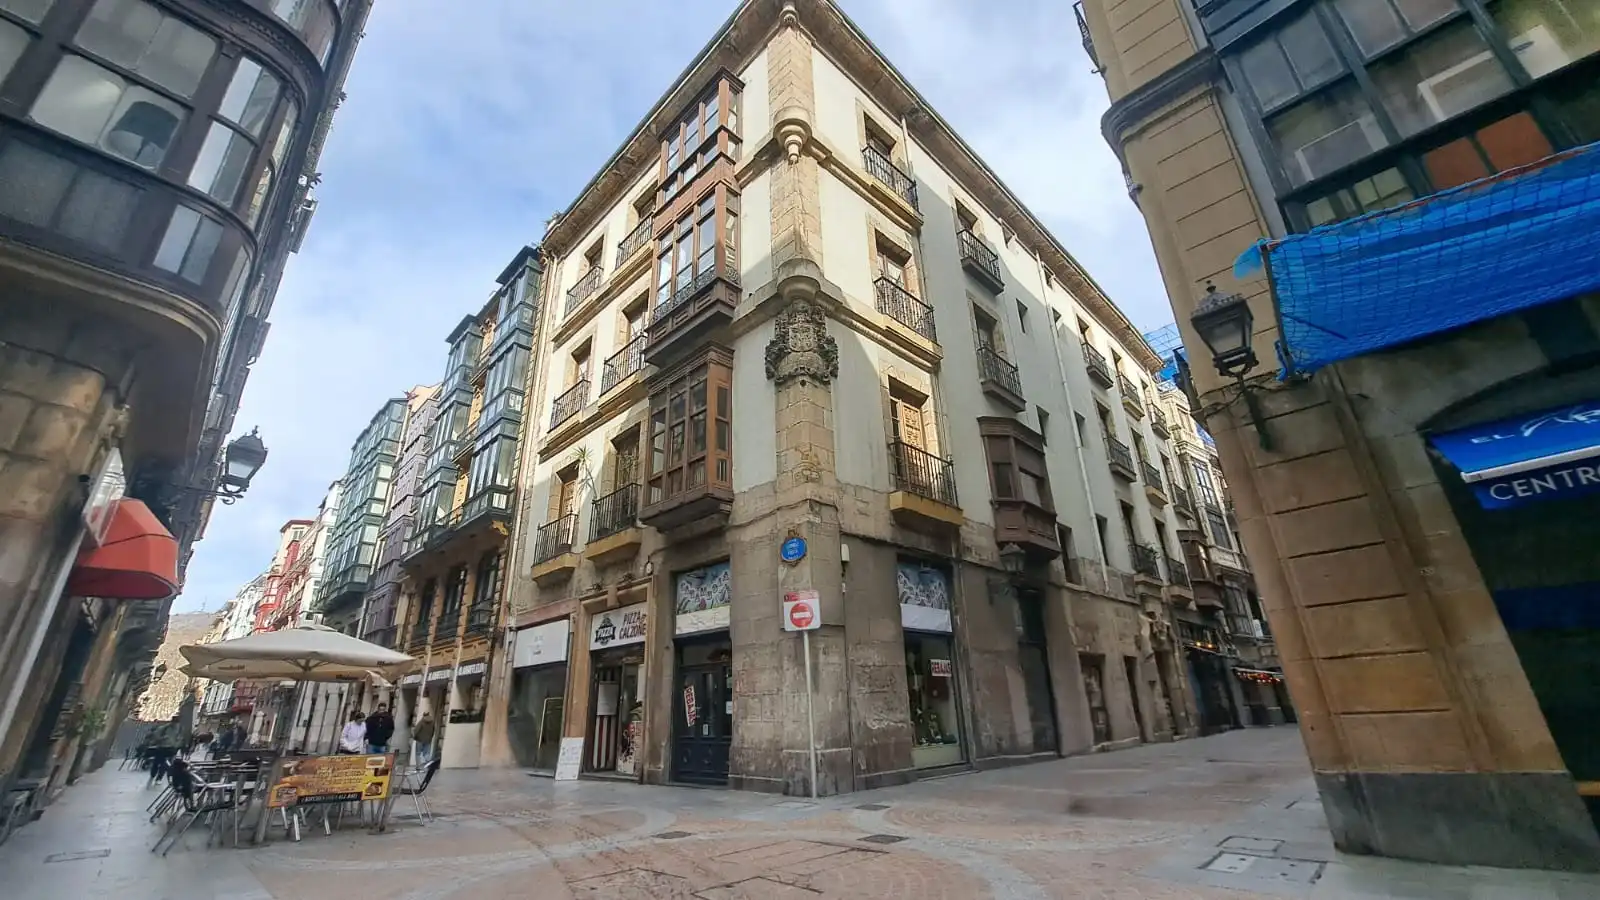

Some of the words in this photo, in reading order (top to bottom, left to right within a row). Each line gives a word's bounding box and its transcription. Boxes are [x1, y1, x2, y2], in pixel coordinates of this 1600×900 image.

[1470, 433, 1516, 444] EL
[1489, 465, 1600, 500] CENTR
[623, 611, 641, 625] PIZZA
[619, 623, 647, 640] CALZONE
